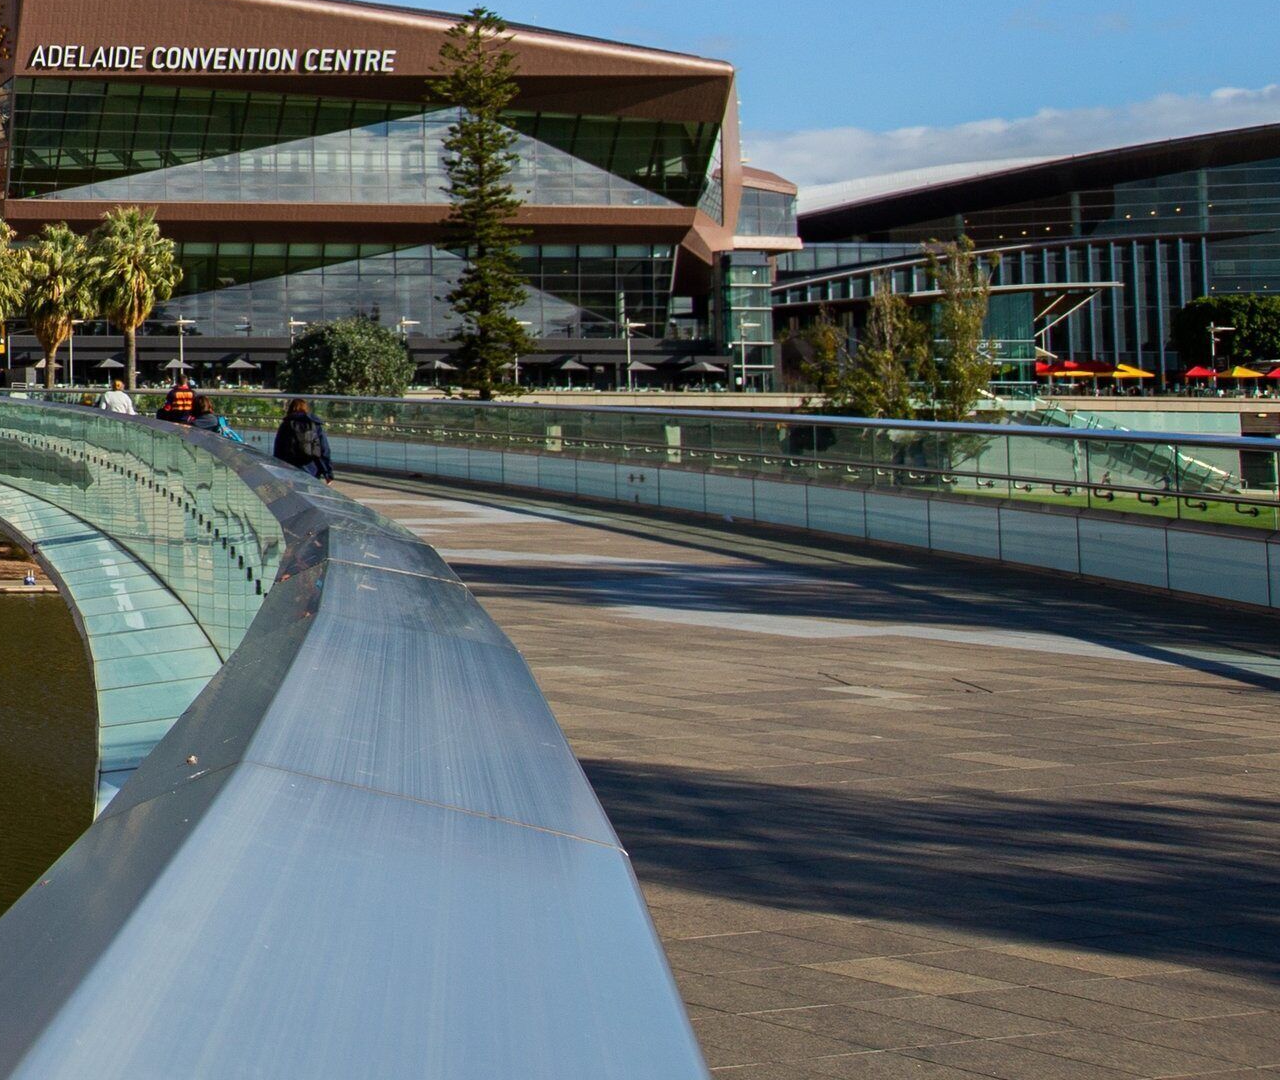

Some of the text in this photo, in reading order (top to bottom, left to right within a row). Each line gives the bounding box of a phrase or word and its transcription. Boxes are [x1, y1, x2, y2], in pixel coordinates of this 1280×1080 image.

[30, 45, 397, 72] ADELAIDE CONVENTION CENTRE
